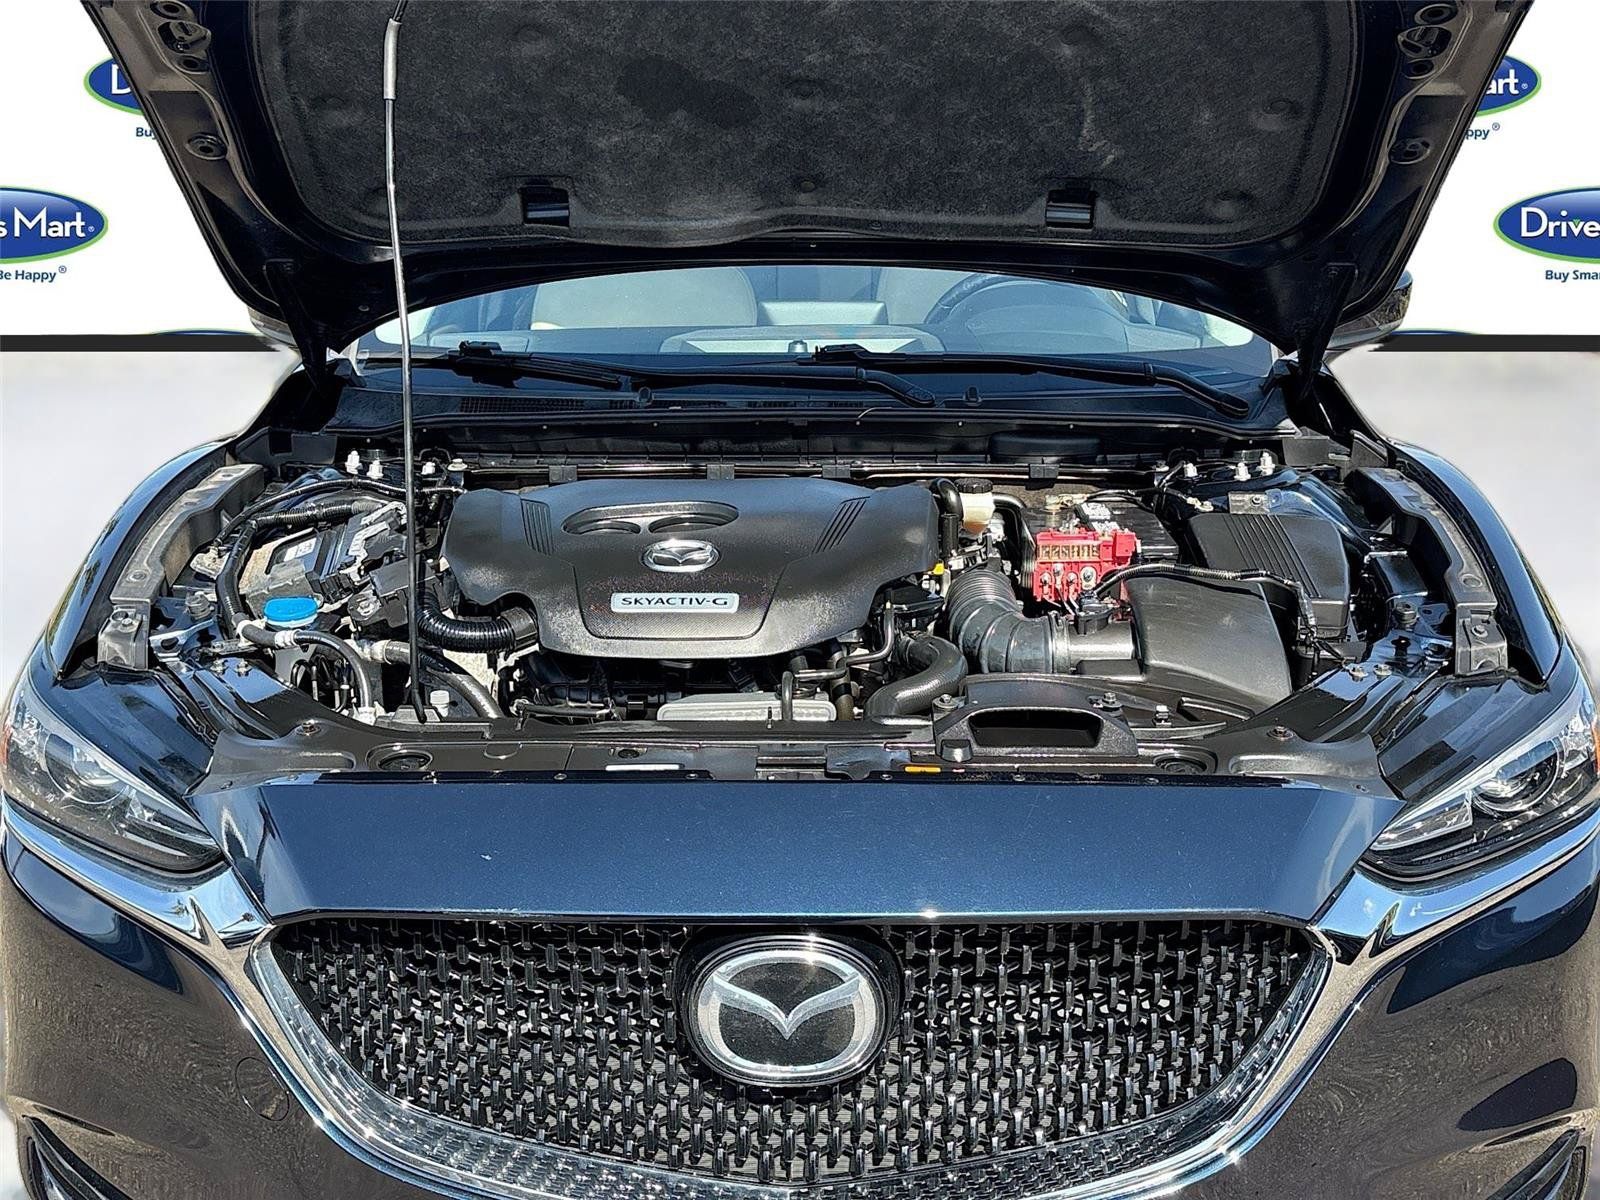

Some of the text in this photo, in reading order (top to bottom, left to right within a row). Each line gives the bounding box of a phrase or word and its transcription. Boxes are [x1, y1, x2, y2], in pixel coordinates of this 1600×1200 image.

[13, 206, 86, 238] Mart
[1521, 206, 1600, 238] Drive
[15, 270, 57, 283] Happy
[1545, 270, 1600, 283] Buy Sma
[621, 596, 728, 606] SKYACTIV-G
